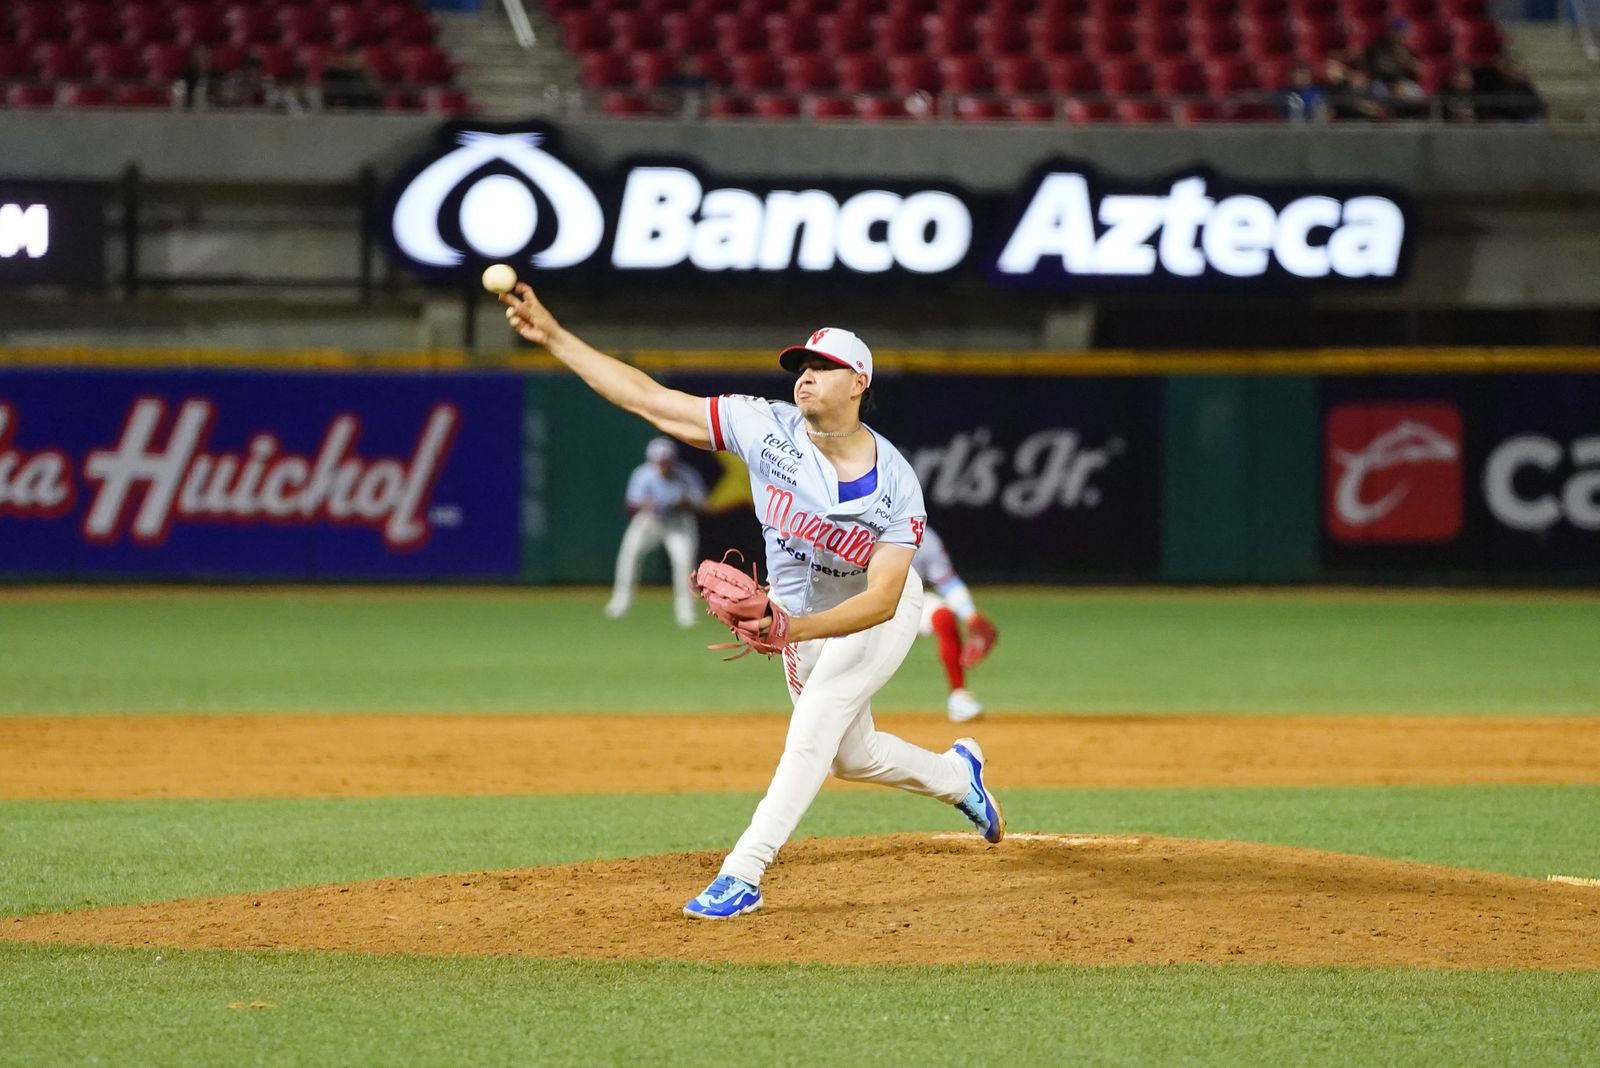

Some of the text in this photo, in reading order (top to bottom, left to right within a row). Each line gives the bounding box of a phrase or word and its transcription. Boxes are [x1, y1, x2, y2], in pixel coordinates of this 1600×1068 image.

[612, 166, 1406, 278] Banco Azteca
[85, 397, 457, 545] Huichol
[771, 469, 798, 486] HERSA
[1003, 429, 1108, 516] Jr.
[777, 537, 806, 562] Red
